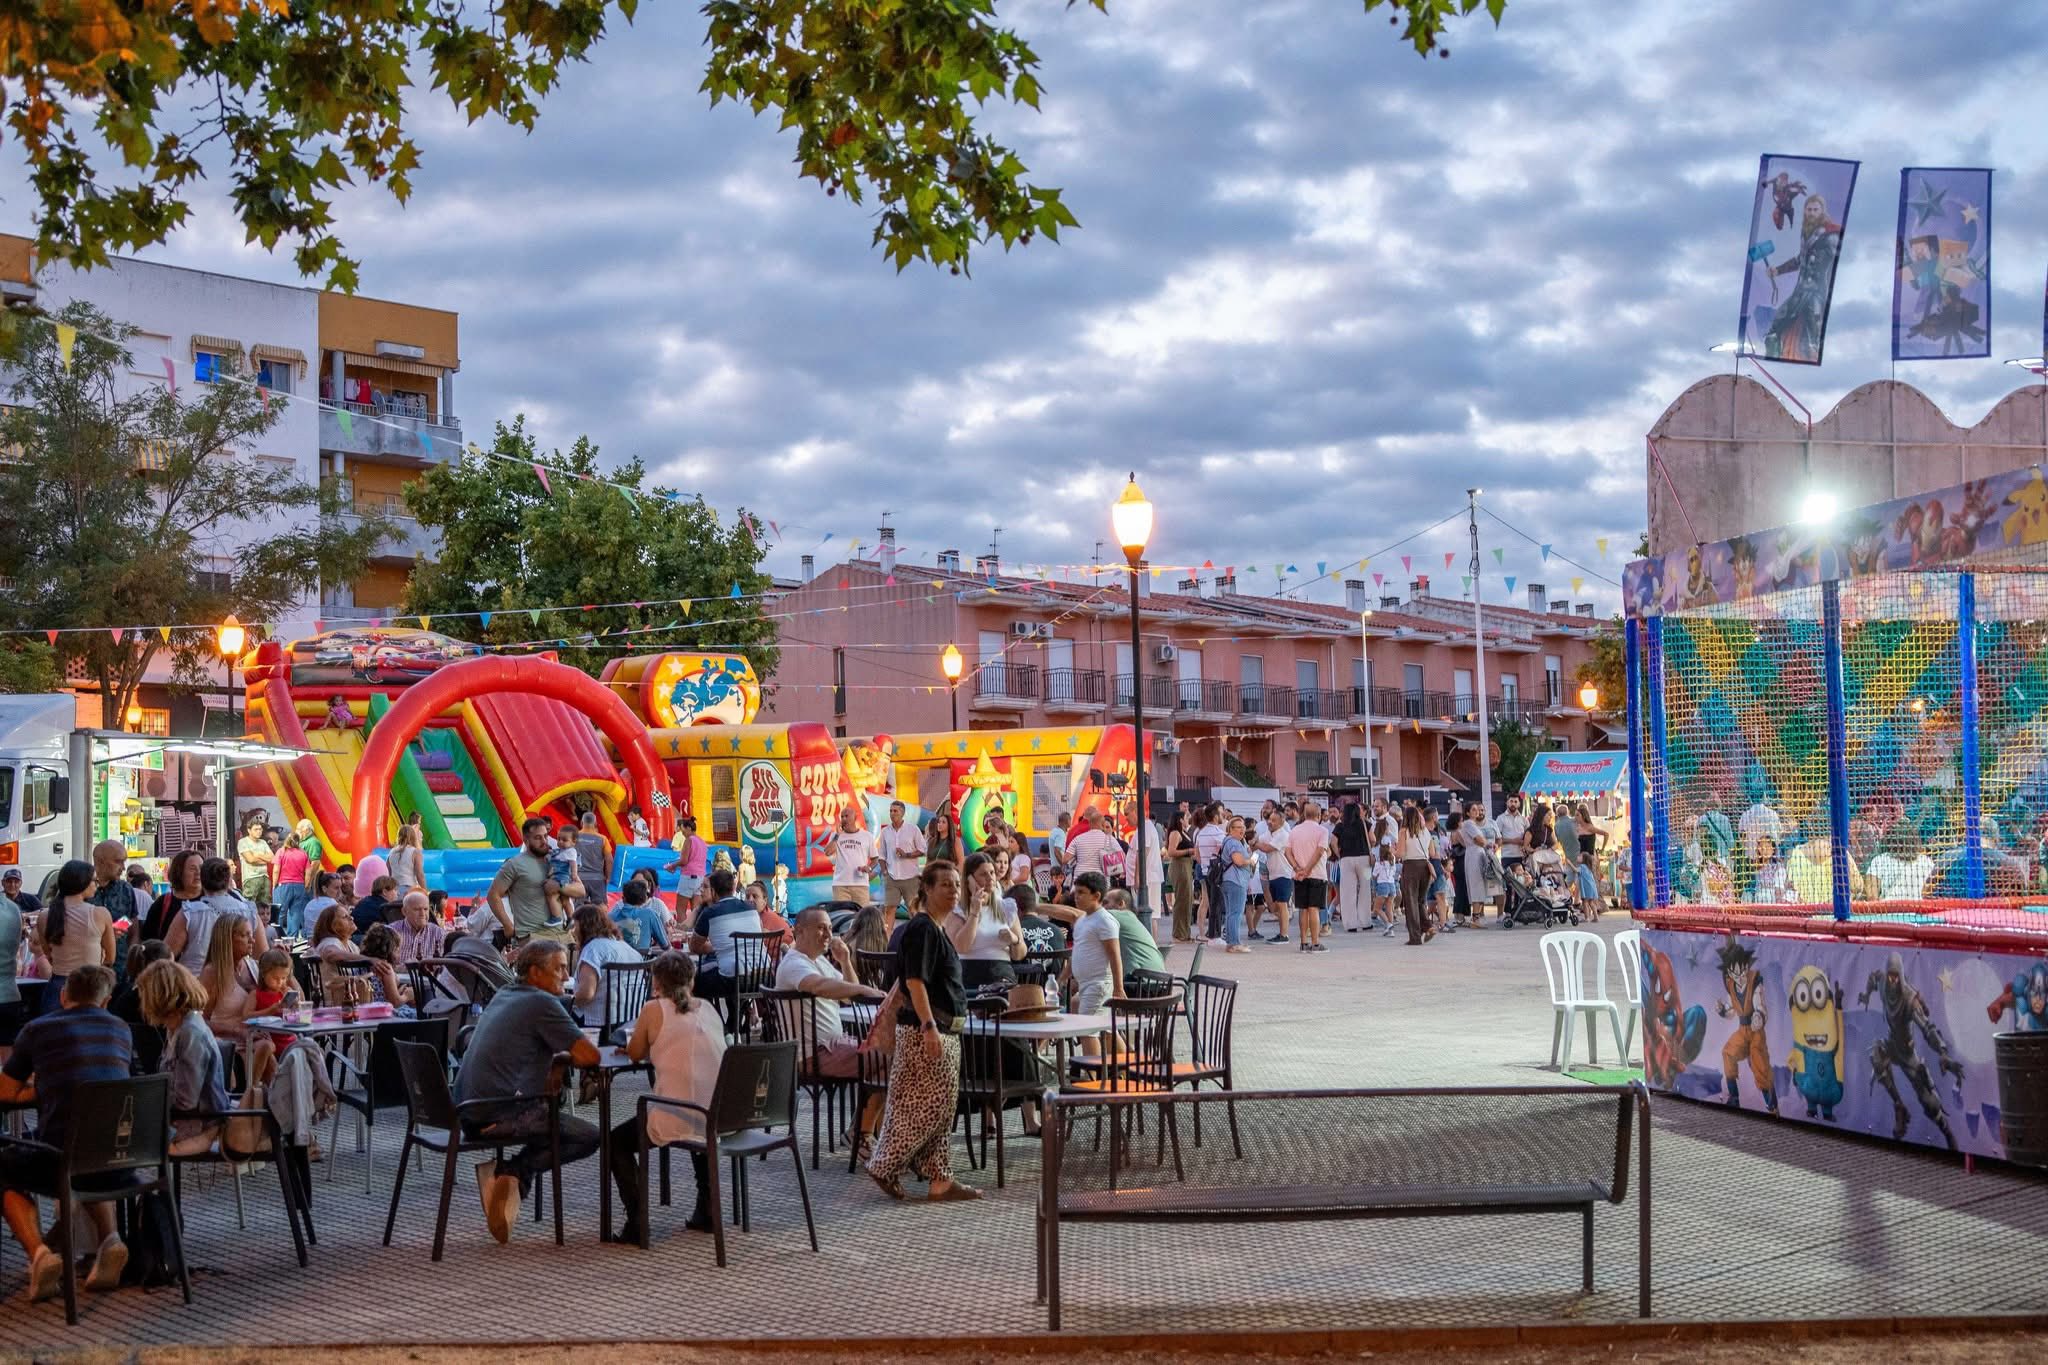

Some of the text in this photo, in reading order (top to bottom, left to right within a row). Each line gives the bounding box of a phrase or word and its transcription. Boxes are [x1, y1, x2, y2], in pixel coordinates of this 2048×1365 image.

[750, 768, 780, 800] BIG
[800, 762, 841, 796] COW
[1552, 765, 1576, 774] SABOR
[810, 793, 850, 825] BOY
